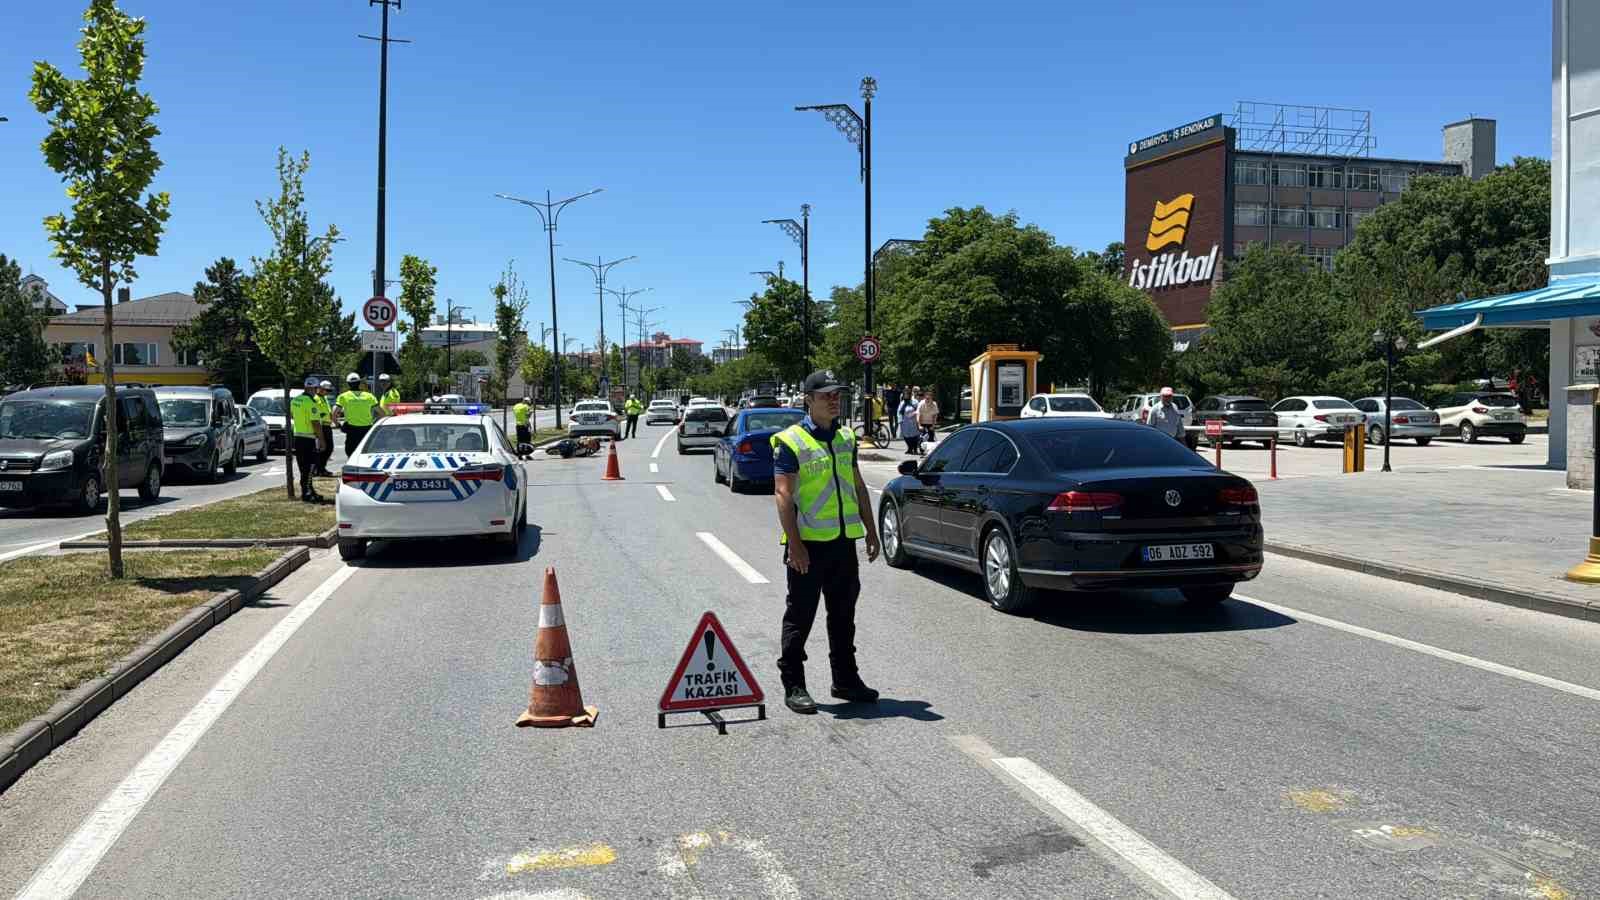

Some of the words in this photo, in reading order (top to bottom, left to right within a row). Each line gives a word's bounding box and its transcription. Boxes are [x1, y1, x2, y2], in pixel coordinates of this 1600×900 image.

[1129, 245, 1219, 290] istikbal
[369, 305, 390, 320] 50
[861, 344, 876, 355] 50
[395, 480, 409, 489] 58
[411, 480, 420, 489] A
[421, 480, 448, 489] 5431
[1149, 547, 1162, 560] 06
[1192, 545, 1212, 557] 592
[685, 669, 738, 686] TRAFİK
[685, 684, 738, 698] KAZASI
